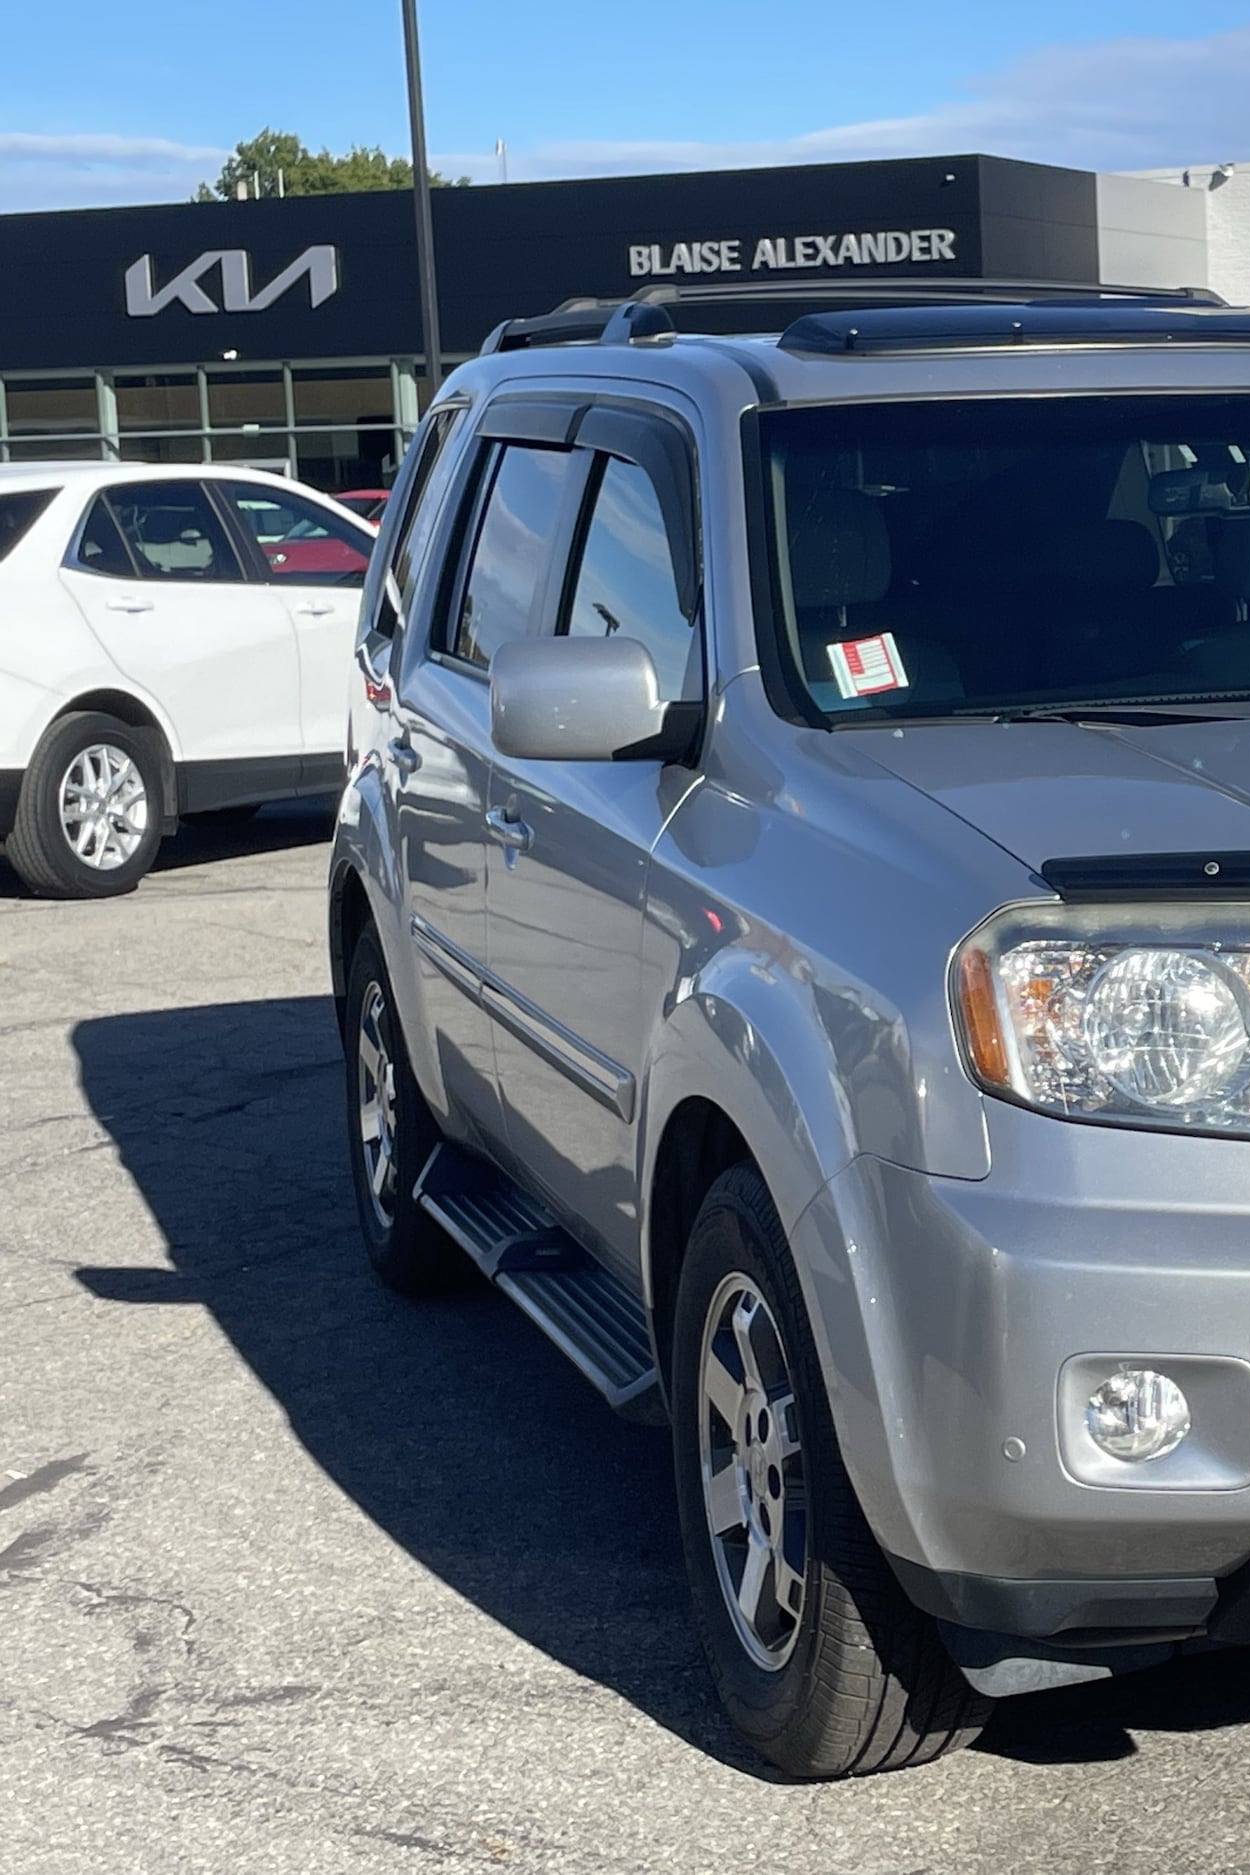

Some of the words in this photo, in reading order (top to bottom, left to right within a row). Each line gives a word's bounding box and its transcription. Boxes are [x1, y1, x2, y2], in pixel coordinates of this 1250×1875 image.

[125, 244, 338, 317] KIA
[629, 240, 741, 276] BLAISE
[752, 228, 956, 270] ALEXANDER
